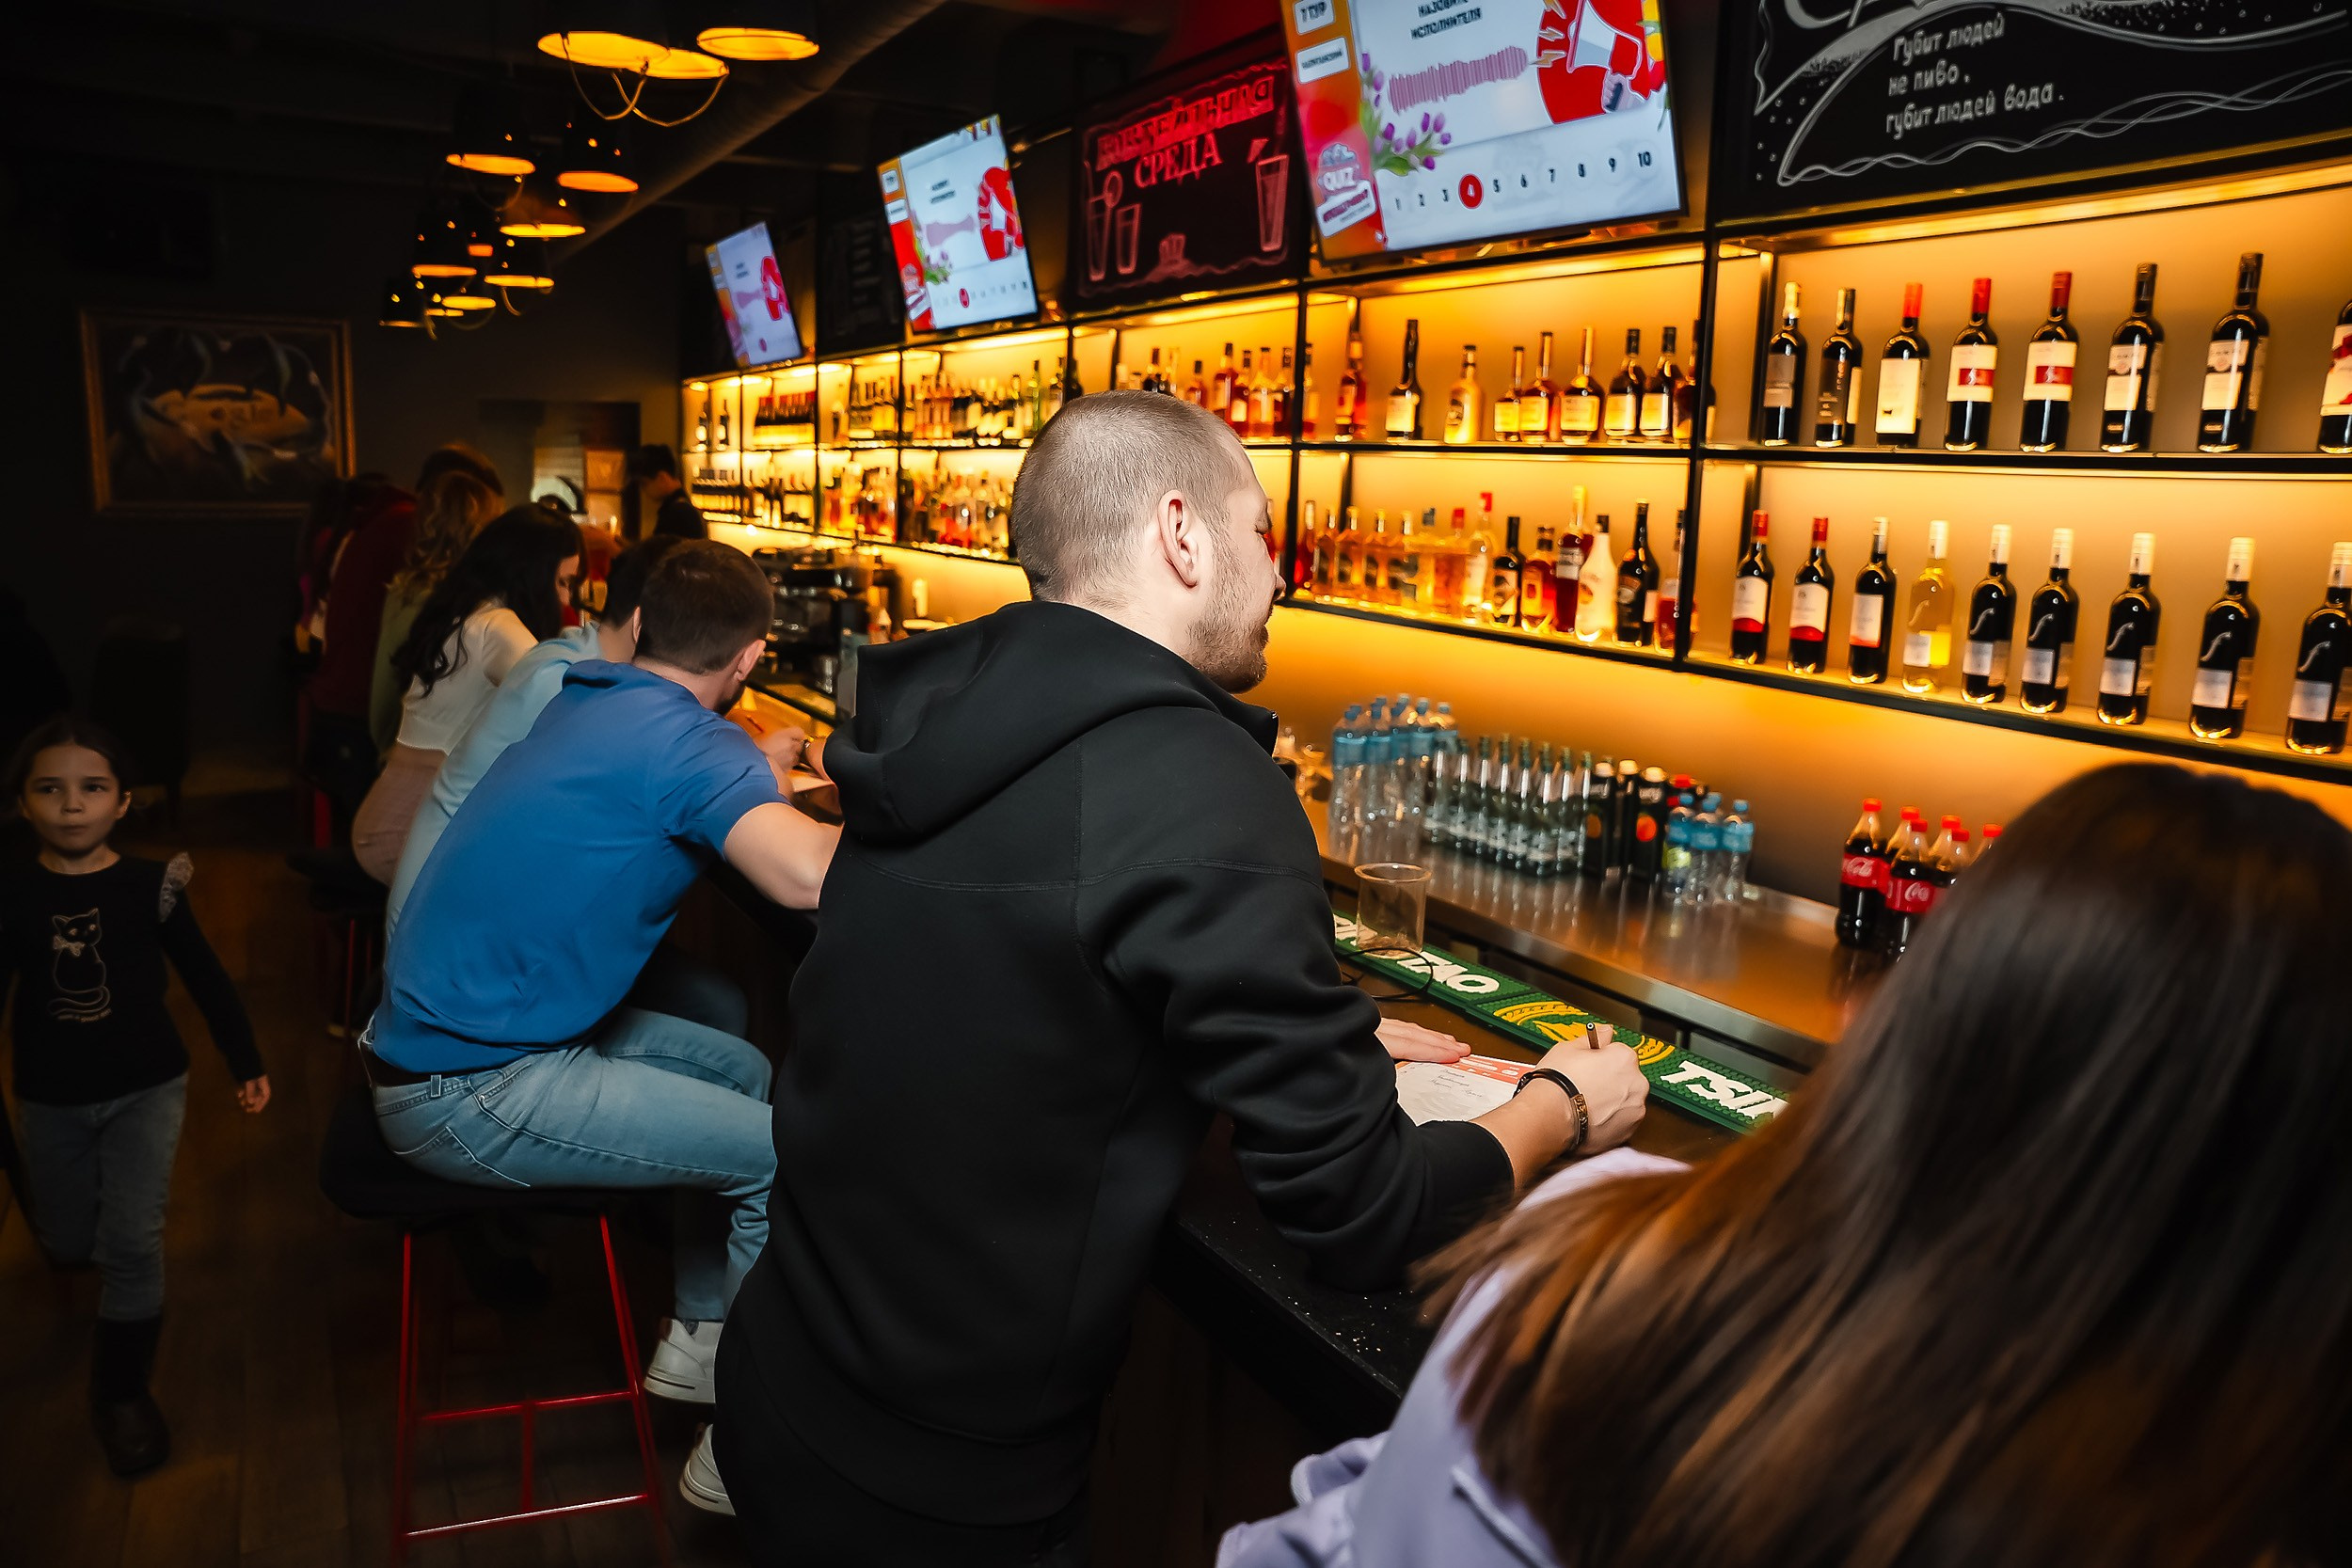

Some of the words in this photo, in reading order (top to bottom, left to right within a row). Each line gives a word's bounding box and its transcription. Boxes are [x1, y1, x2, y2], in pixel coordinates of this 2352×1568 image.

[1893, 29, 1944, 67] Губит
[1946, 11, 2006, 50] людей
[1888, 74, 1909, 97] не
[1886, 101, 1934, 140] губит
[1933, 89, 1996, 125] людей
[1135, 133, 1224, 188] СРЕДА
[1418, 193, 1425, 207] 2
[1441, 188, 1449, 202] 3
[1493, 179, 1501, 193] 5
[1549, 168, 1555, 183] 7
[1578, 163, 1586, 178] 8
[1608, 157, 1616, 173] 9
[1637, 150, 1652, 167] 10
